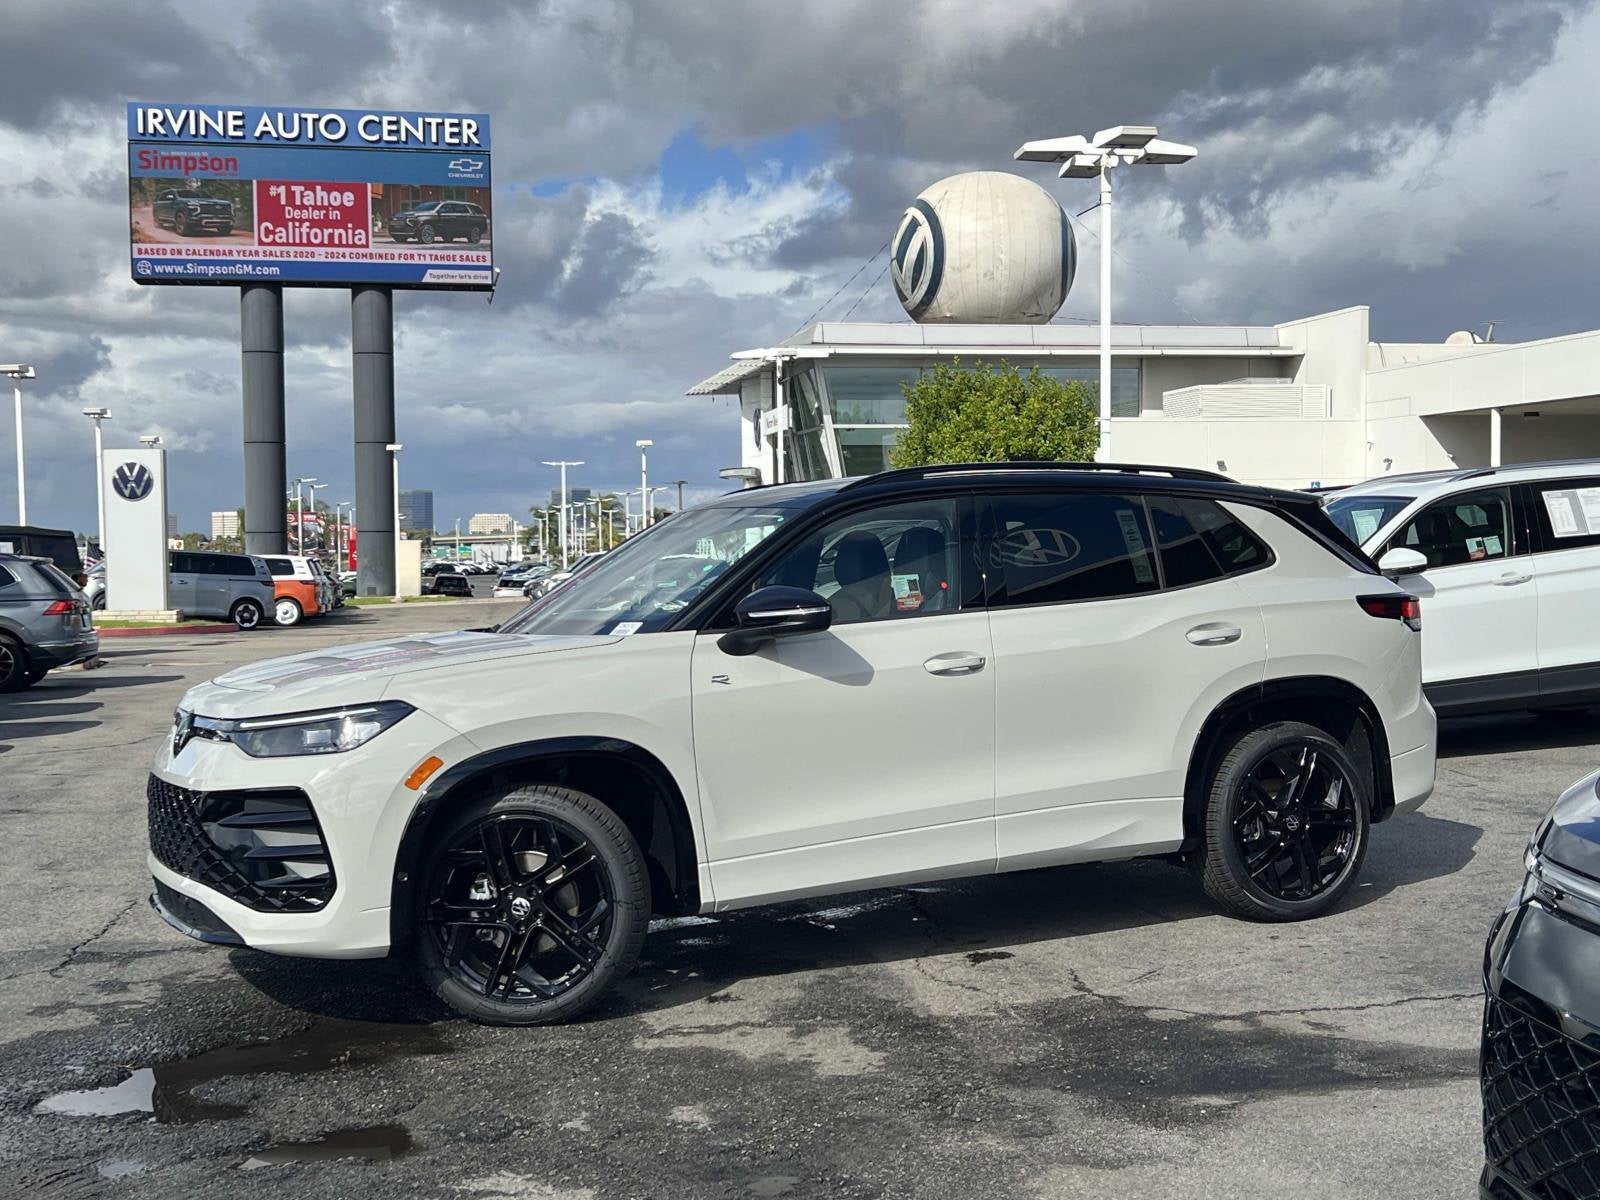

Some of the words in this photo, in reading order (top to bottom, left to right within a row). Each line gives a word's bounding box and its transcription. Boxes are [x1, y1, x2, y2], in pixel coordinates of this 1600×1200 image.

[137, 108, 244, 137] IRVINE
[254, 112, 347, 140] AUTO
[357, 115, 480, 145] CENTER
[138, 149, 238, 176] Simpson
[269, 185, 286, 205] #1
[291, 185, 355, 207] Tahoe
[285, 206, 326, 219] Dealer
[329, 207, 341, 220] in
[260, 221, 366, 245] California
[137, 247, 167, 256] BASED
[170, 248, 183, 256] ON
[185, 248, 234, 257] CALENDAR
[236, 249, 260, 258] YEAR
[262, 250, 291, 258] SALES
[293, 250, 316, 259] 2020
[324, 251, 347, 259] 2024
[349, 252, 396, 260] COMBINED
[398, 252, 415, 261] FOR
[417, 253, 427, 261] T1
[429, 253, 457, 262] TAHOE
[459, 254, 487, 262] SALES
[154, 262, 280, 277] www.SimpsonGM.com
[429, 272, 458, 280] Together
